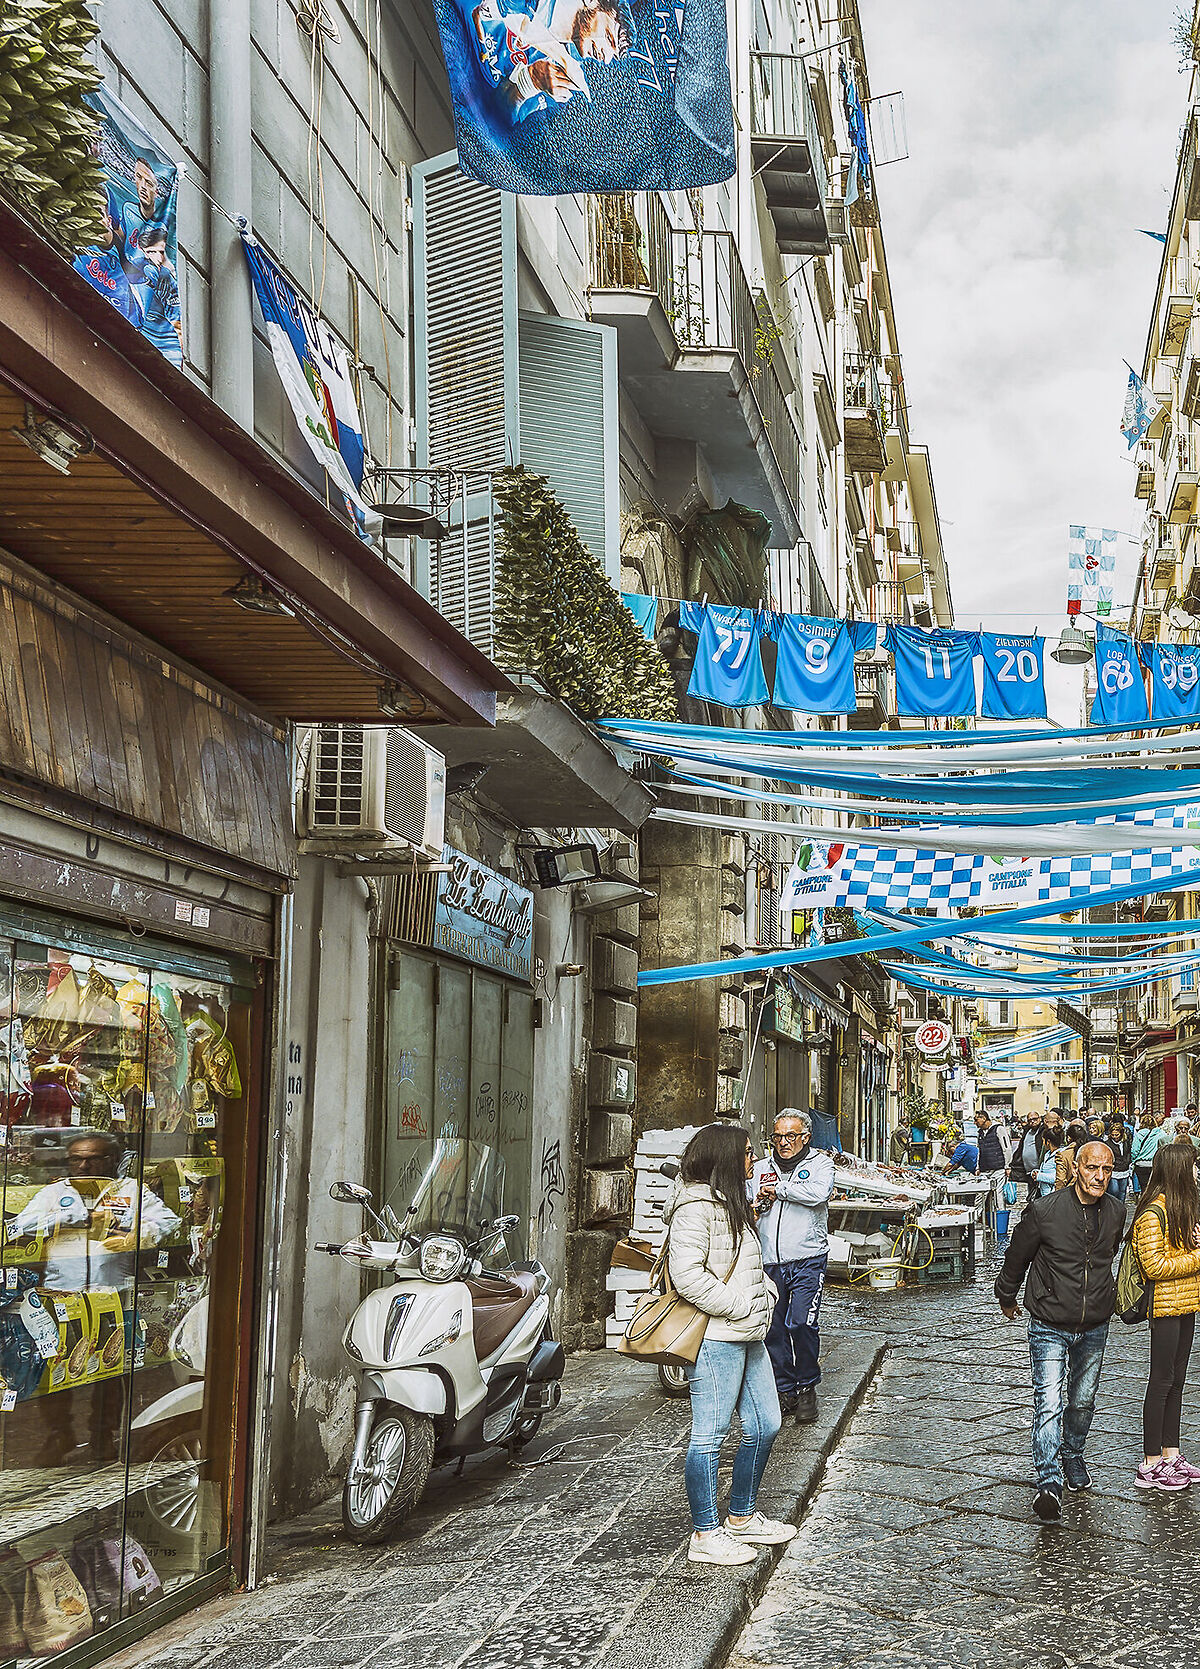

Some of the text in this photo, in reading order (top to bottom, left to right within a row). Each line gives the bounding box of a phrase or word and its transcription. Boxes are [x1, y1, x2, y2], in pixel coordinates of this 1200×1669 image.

[711, 626, 751, 669] 77
[994, 637, 1033, 648] ZIELINSKI
[804, 638, 831, 674] 9
[918, 646, 951, 679] 11
[994, 649, 1039, 683] 20
[1106, 649, 1126, 661] LOB
[1101, 660, 1134, 694] 68
[1160, 658, 1199, 692] 99
[791, 874, 833, 888] CAMPIONE
[988, 868, 1033, 882] CAMPIONE
[992, 879, 1028, 891] D'ITALIA
[793, 883, 827, 896] D'ITALIA
[436, 922, 482, 959] TRIPPERIA
[922, 1028, 942, 1044] 22
